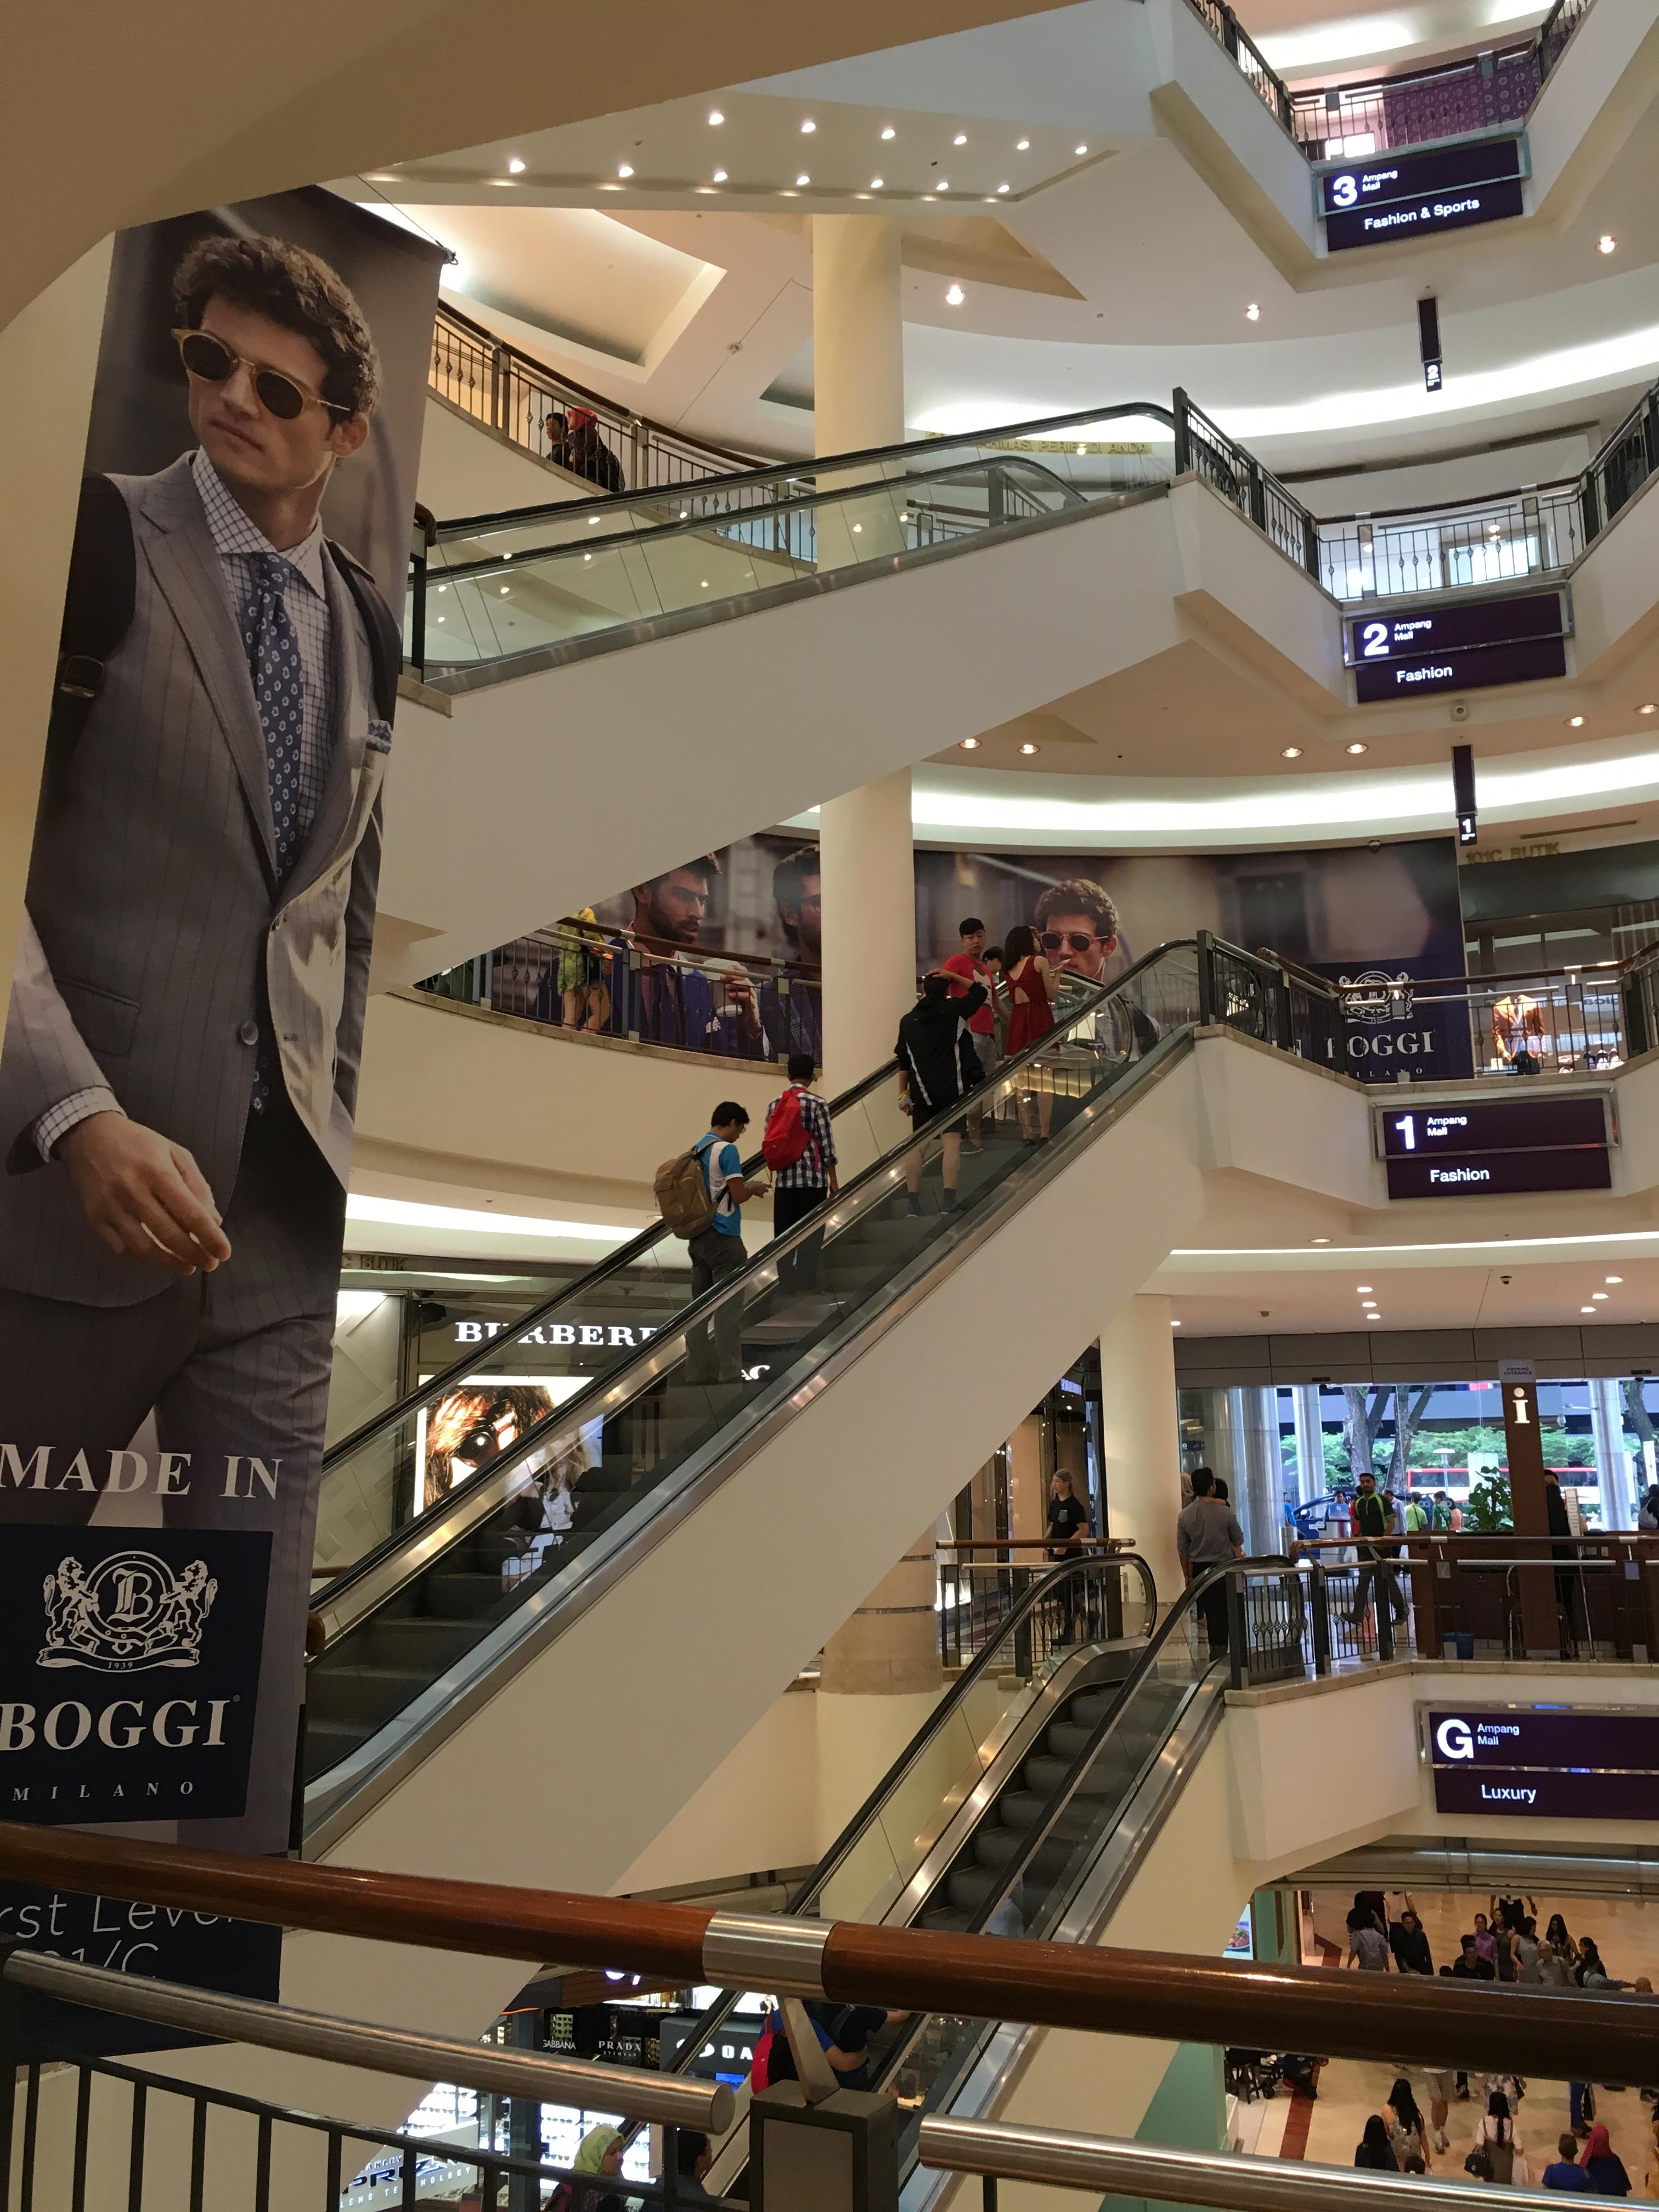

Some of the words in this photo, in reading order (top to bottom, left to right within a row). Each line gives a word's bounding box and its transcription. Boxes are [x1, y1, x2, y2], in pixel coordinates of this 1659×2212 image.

[1362, 170, 1398, 183] Ampang
[1334, 176, 1358, 206] 3
[1363, 182, 1380, 192] Mall
[1364, 210, 1417, 230] Fashion
[1420, 207, 1431, 218] &
[1434, 198, 1480, 217] Sports
[1427, 364, 1438, 380] 2
[1394, 620, 1432, 631] Ampang
[1363, 623, 1389, 656] 2
[1395, 631, 1413, 641] Mall
[1396, 666, 1453, 683] Fashion
[1463, 819, 1471, 833] 1
[1427, 1116, 1467, 1126] Ampang
[1396, 1116, 1415, 1149] 1
[1427, 1127, 1448, 1136] Mall
[1430, 1168, 1490, 1183] Fashion
[0, 1443, 191, 1495] MADE
[219, 1455, 284, 1500] IN
[108, 1661, 133, 1669] 1939
[0, 1700, 230, 1751] BOGGI
[1477, 1723, 1520, 1736] Ampang
[1437, 1719, 1474, 1759] G
[1478, 1735, 1499, 1745] Mall
[13, 1781, 194, 1802] MILANO
[1481, 1784, 1536, 1804] Luxury
[599, 2040, 641, 2052] PRADA
[361, 2155, 402, 2171] AKLEY
[385, 2166, 471, 2197] TENOLOGY
